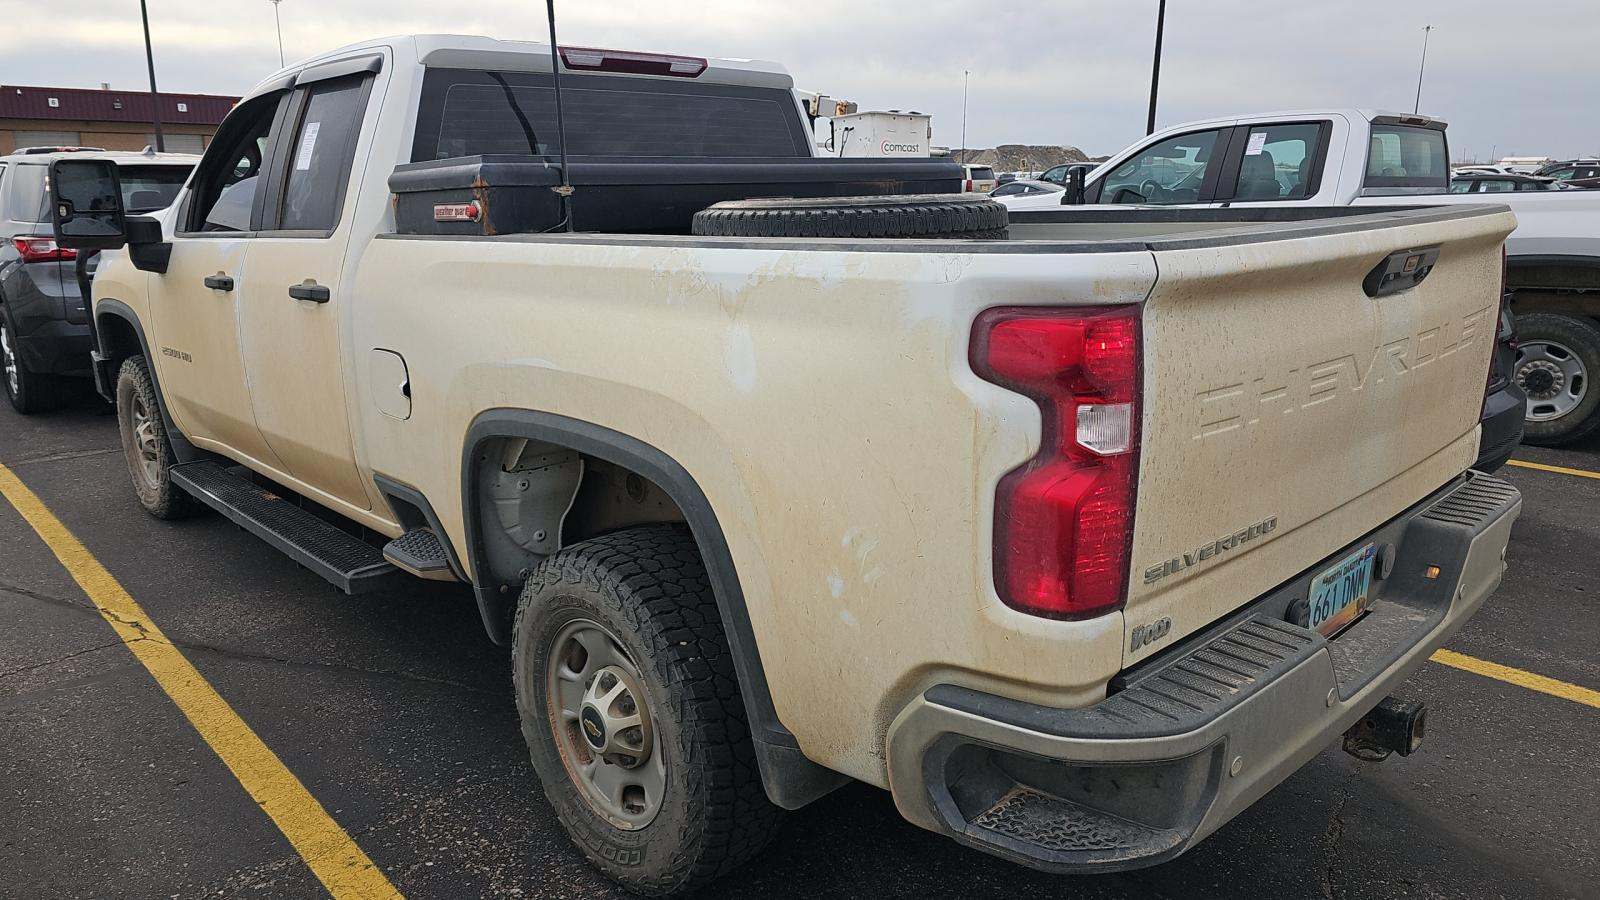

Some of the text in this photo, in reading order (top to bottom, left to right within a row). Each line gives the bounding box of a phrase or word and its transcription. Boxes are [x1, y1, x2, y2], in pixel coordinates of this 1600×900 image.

[882, 141, 919, 153] comcast
[1144, 515, 1277, 585] SILVERADO
[1313, 583, 1338, 628] 661
